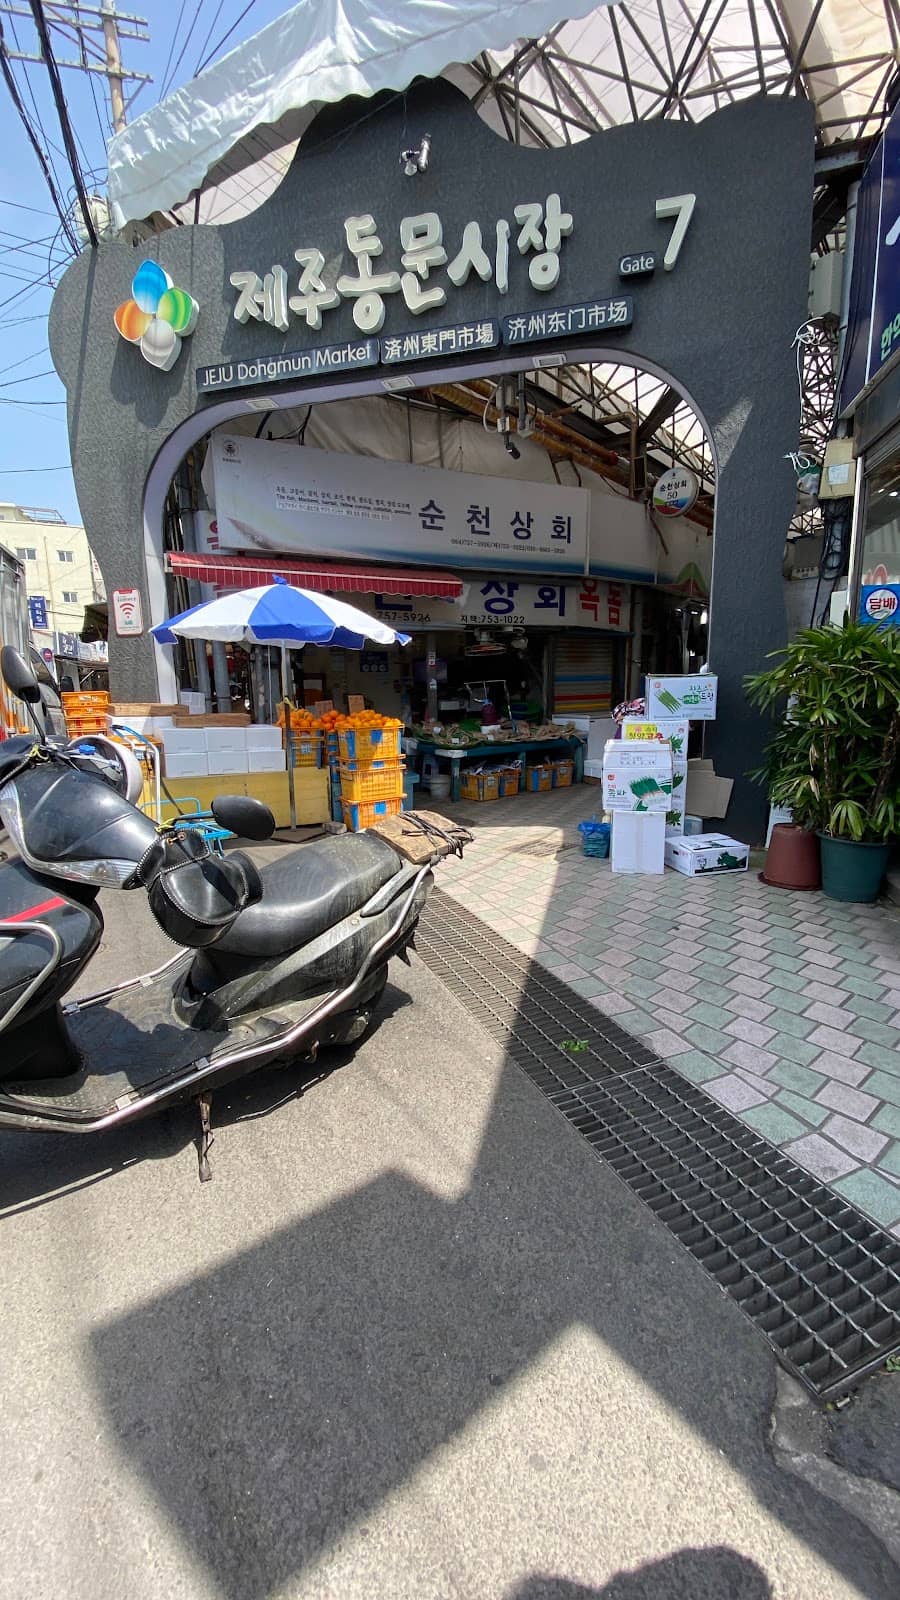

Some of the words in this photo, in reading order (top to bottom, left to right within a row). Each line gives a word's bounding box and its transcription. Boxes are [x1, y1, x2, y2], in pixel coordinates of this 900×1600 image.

[656, 193, 696, 271] 7
[229, 193, 574, 334] 제주동문시장
[620, 255, 655, 273] Gate
[384, 322, 495, 360] 済州東門市場
[508, 300, 628, 341] 济州东门市场
[202, 365, 234, 386] JEJU
[237, 355, 312, 380] Dongmun
[316, 343, 371, 368] Market
[418, 499, 573, 544] 순천상회
[869, 597, 896, 611] 담배
